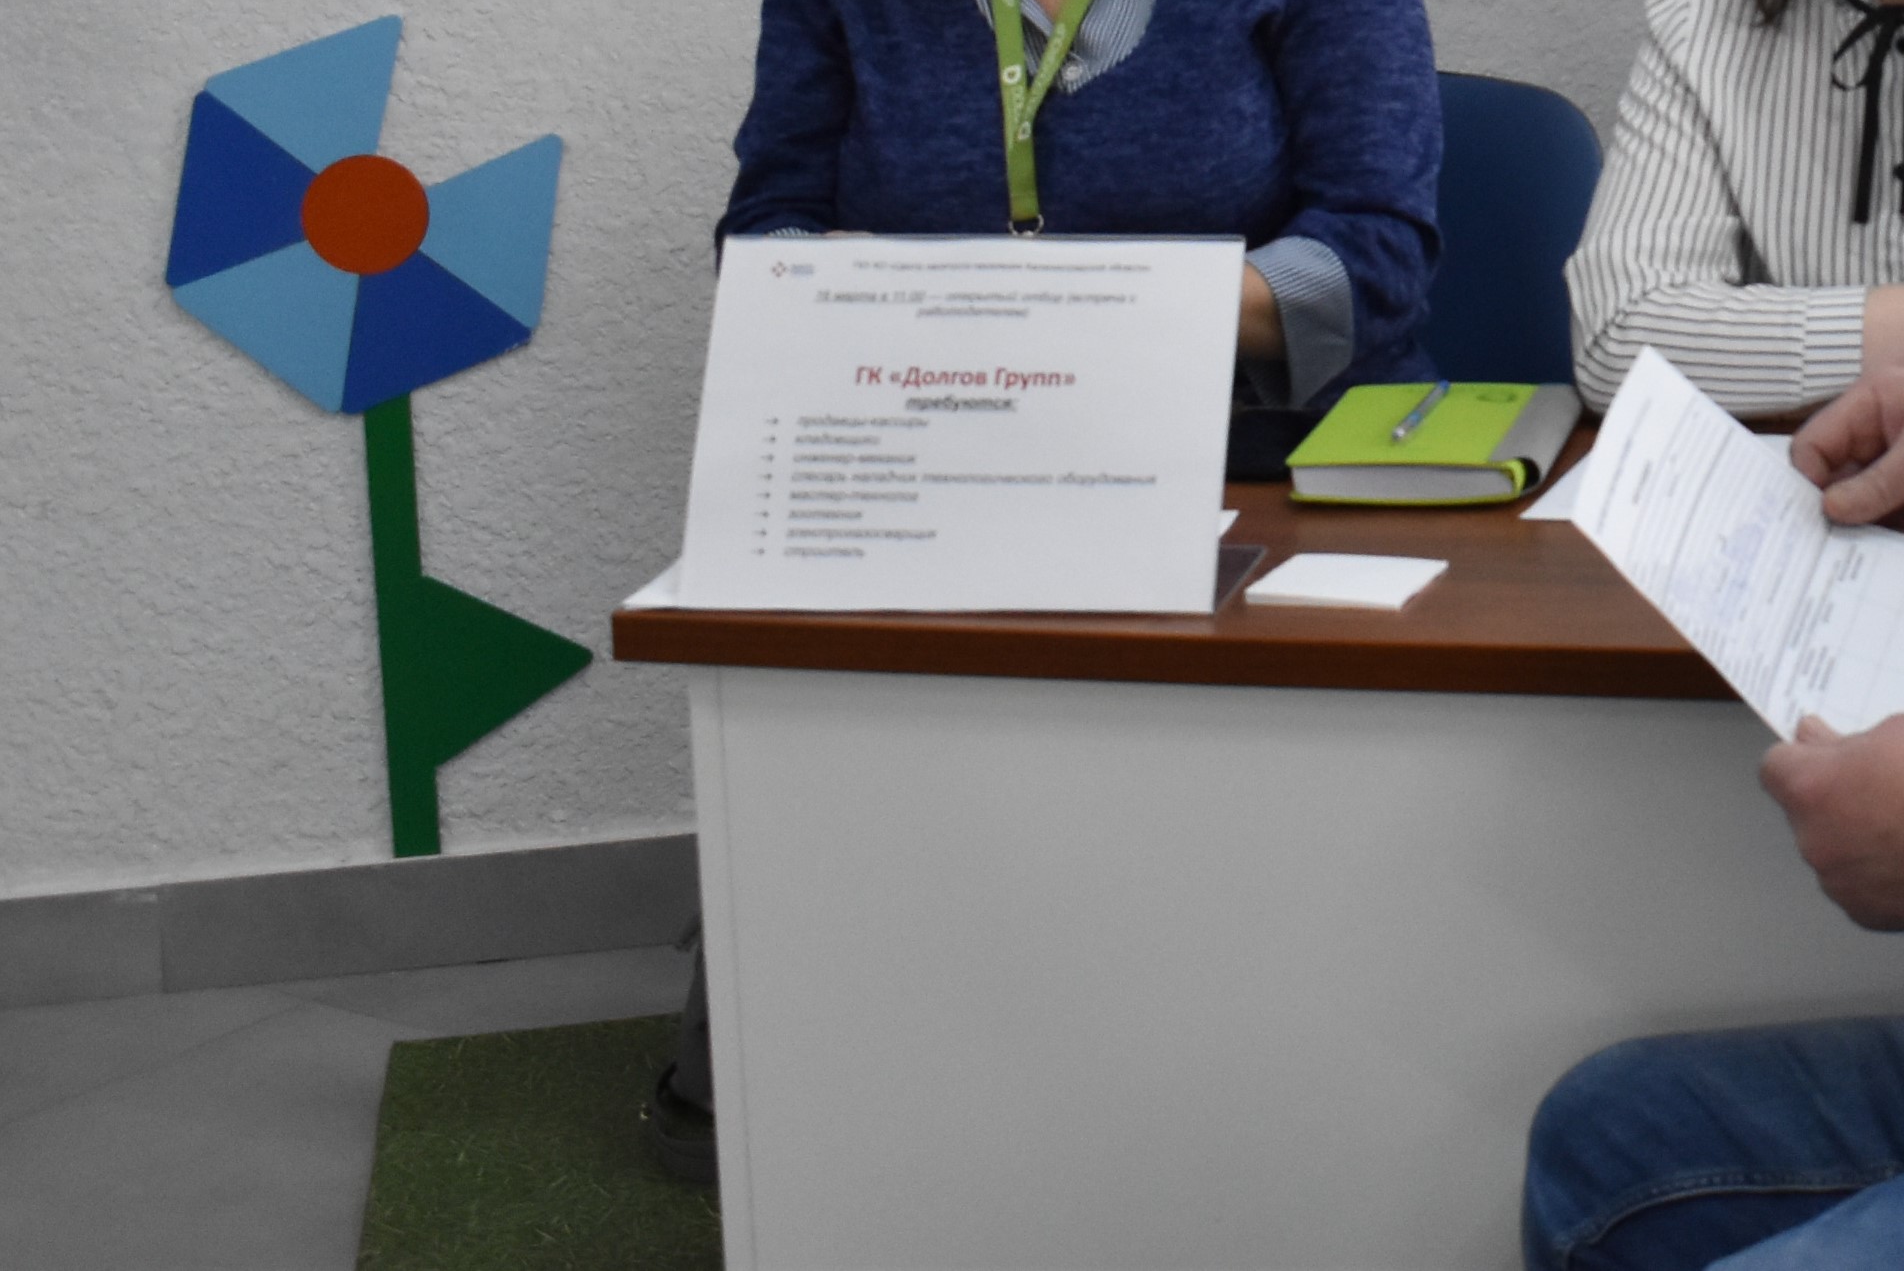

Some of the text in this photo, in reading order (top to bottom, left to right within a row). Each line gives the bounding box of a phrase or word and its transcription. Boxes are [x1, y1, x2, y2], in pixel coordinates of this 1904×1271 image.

[854, 366, 1076, 390] ГК «Долгов Групп»
